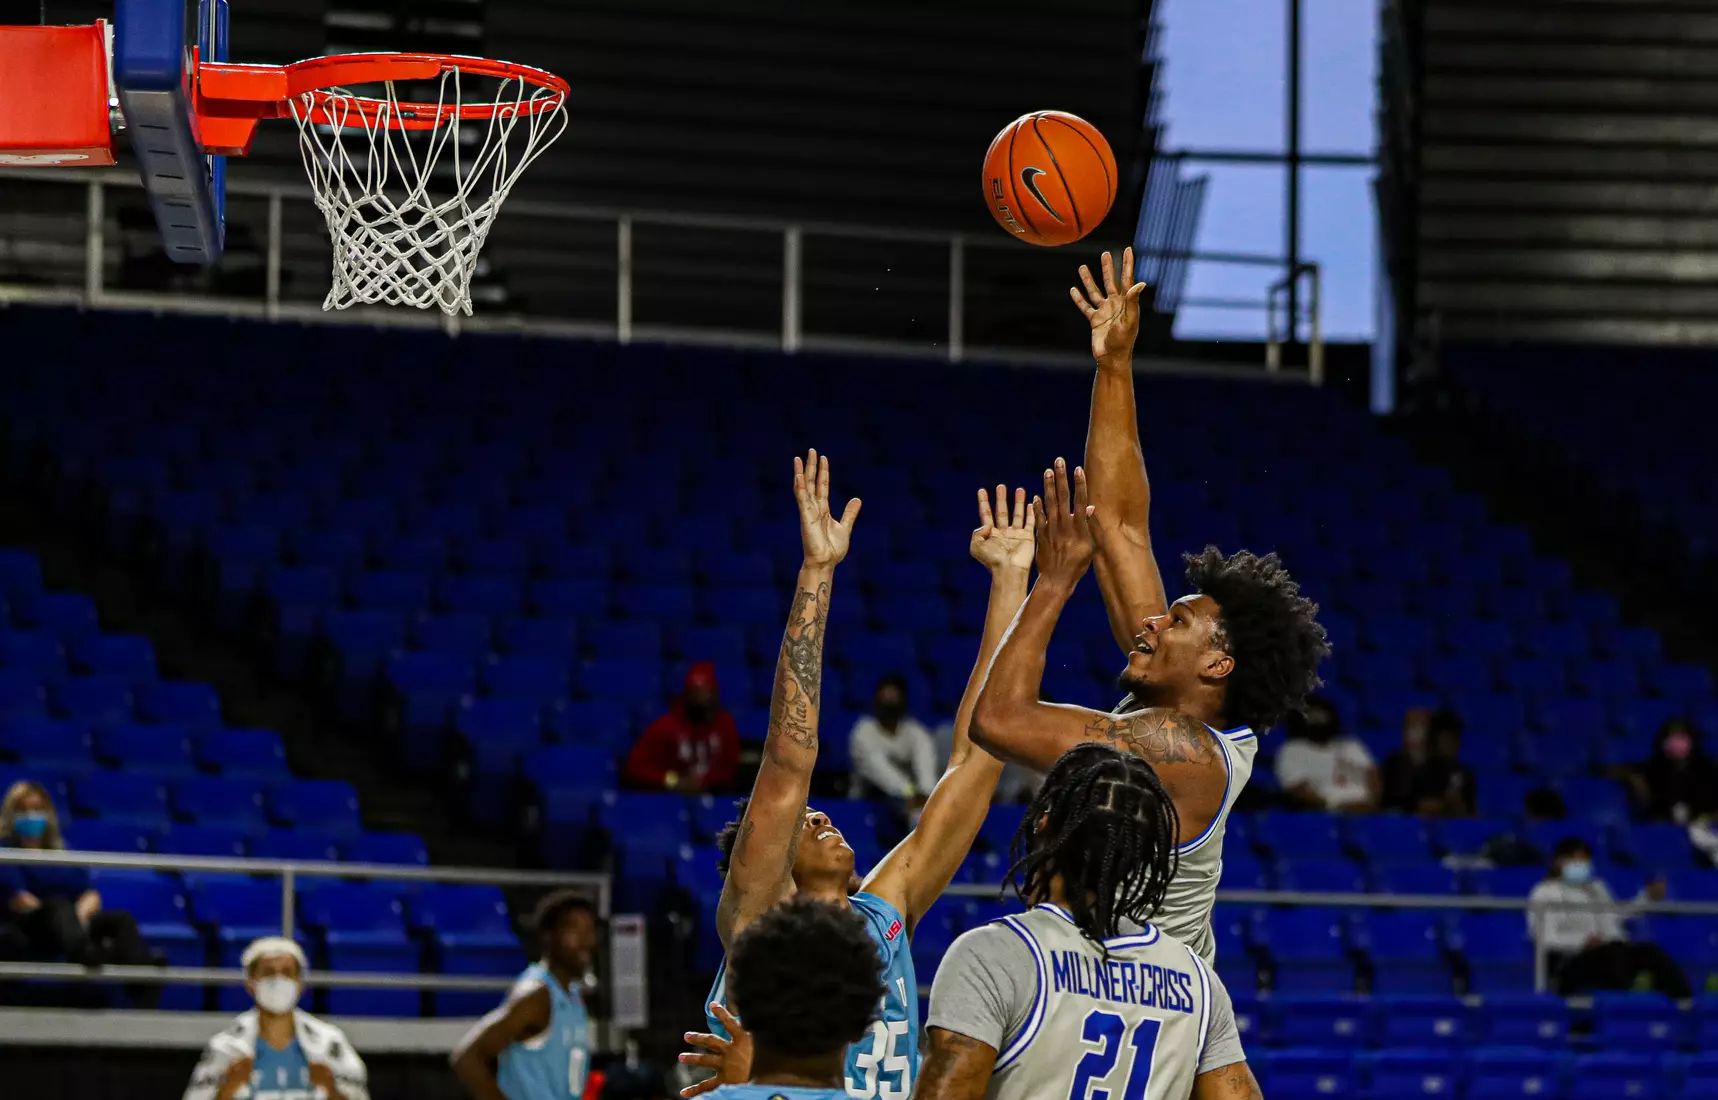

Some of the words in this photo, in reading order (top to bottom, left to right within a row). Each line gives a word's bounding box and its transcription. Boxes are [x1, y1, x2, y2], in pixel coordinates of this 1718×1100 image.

[1050, 950, 1194, 1014] MILLNER-CRISS
[844, 1020, 910, 1100] 35
[1067, 1008, 1164, 1100] 21
